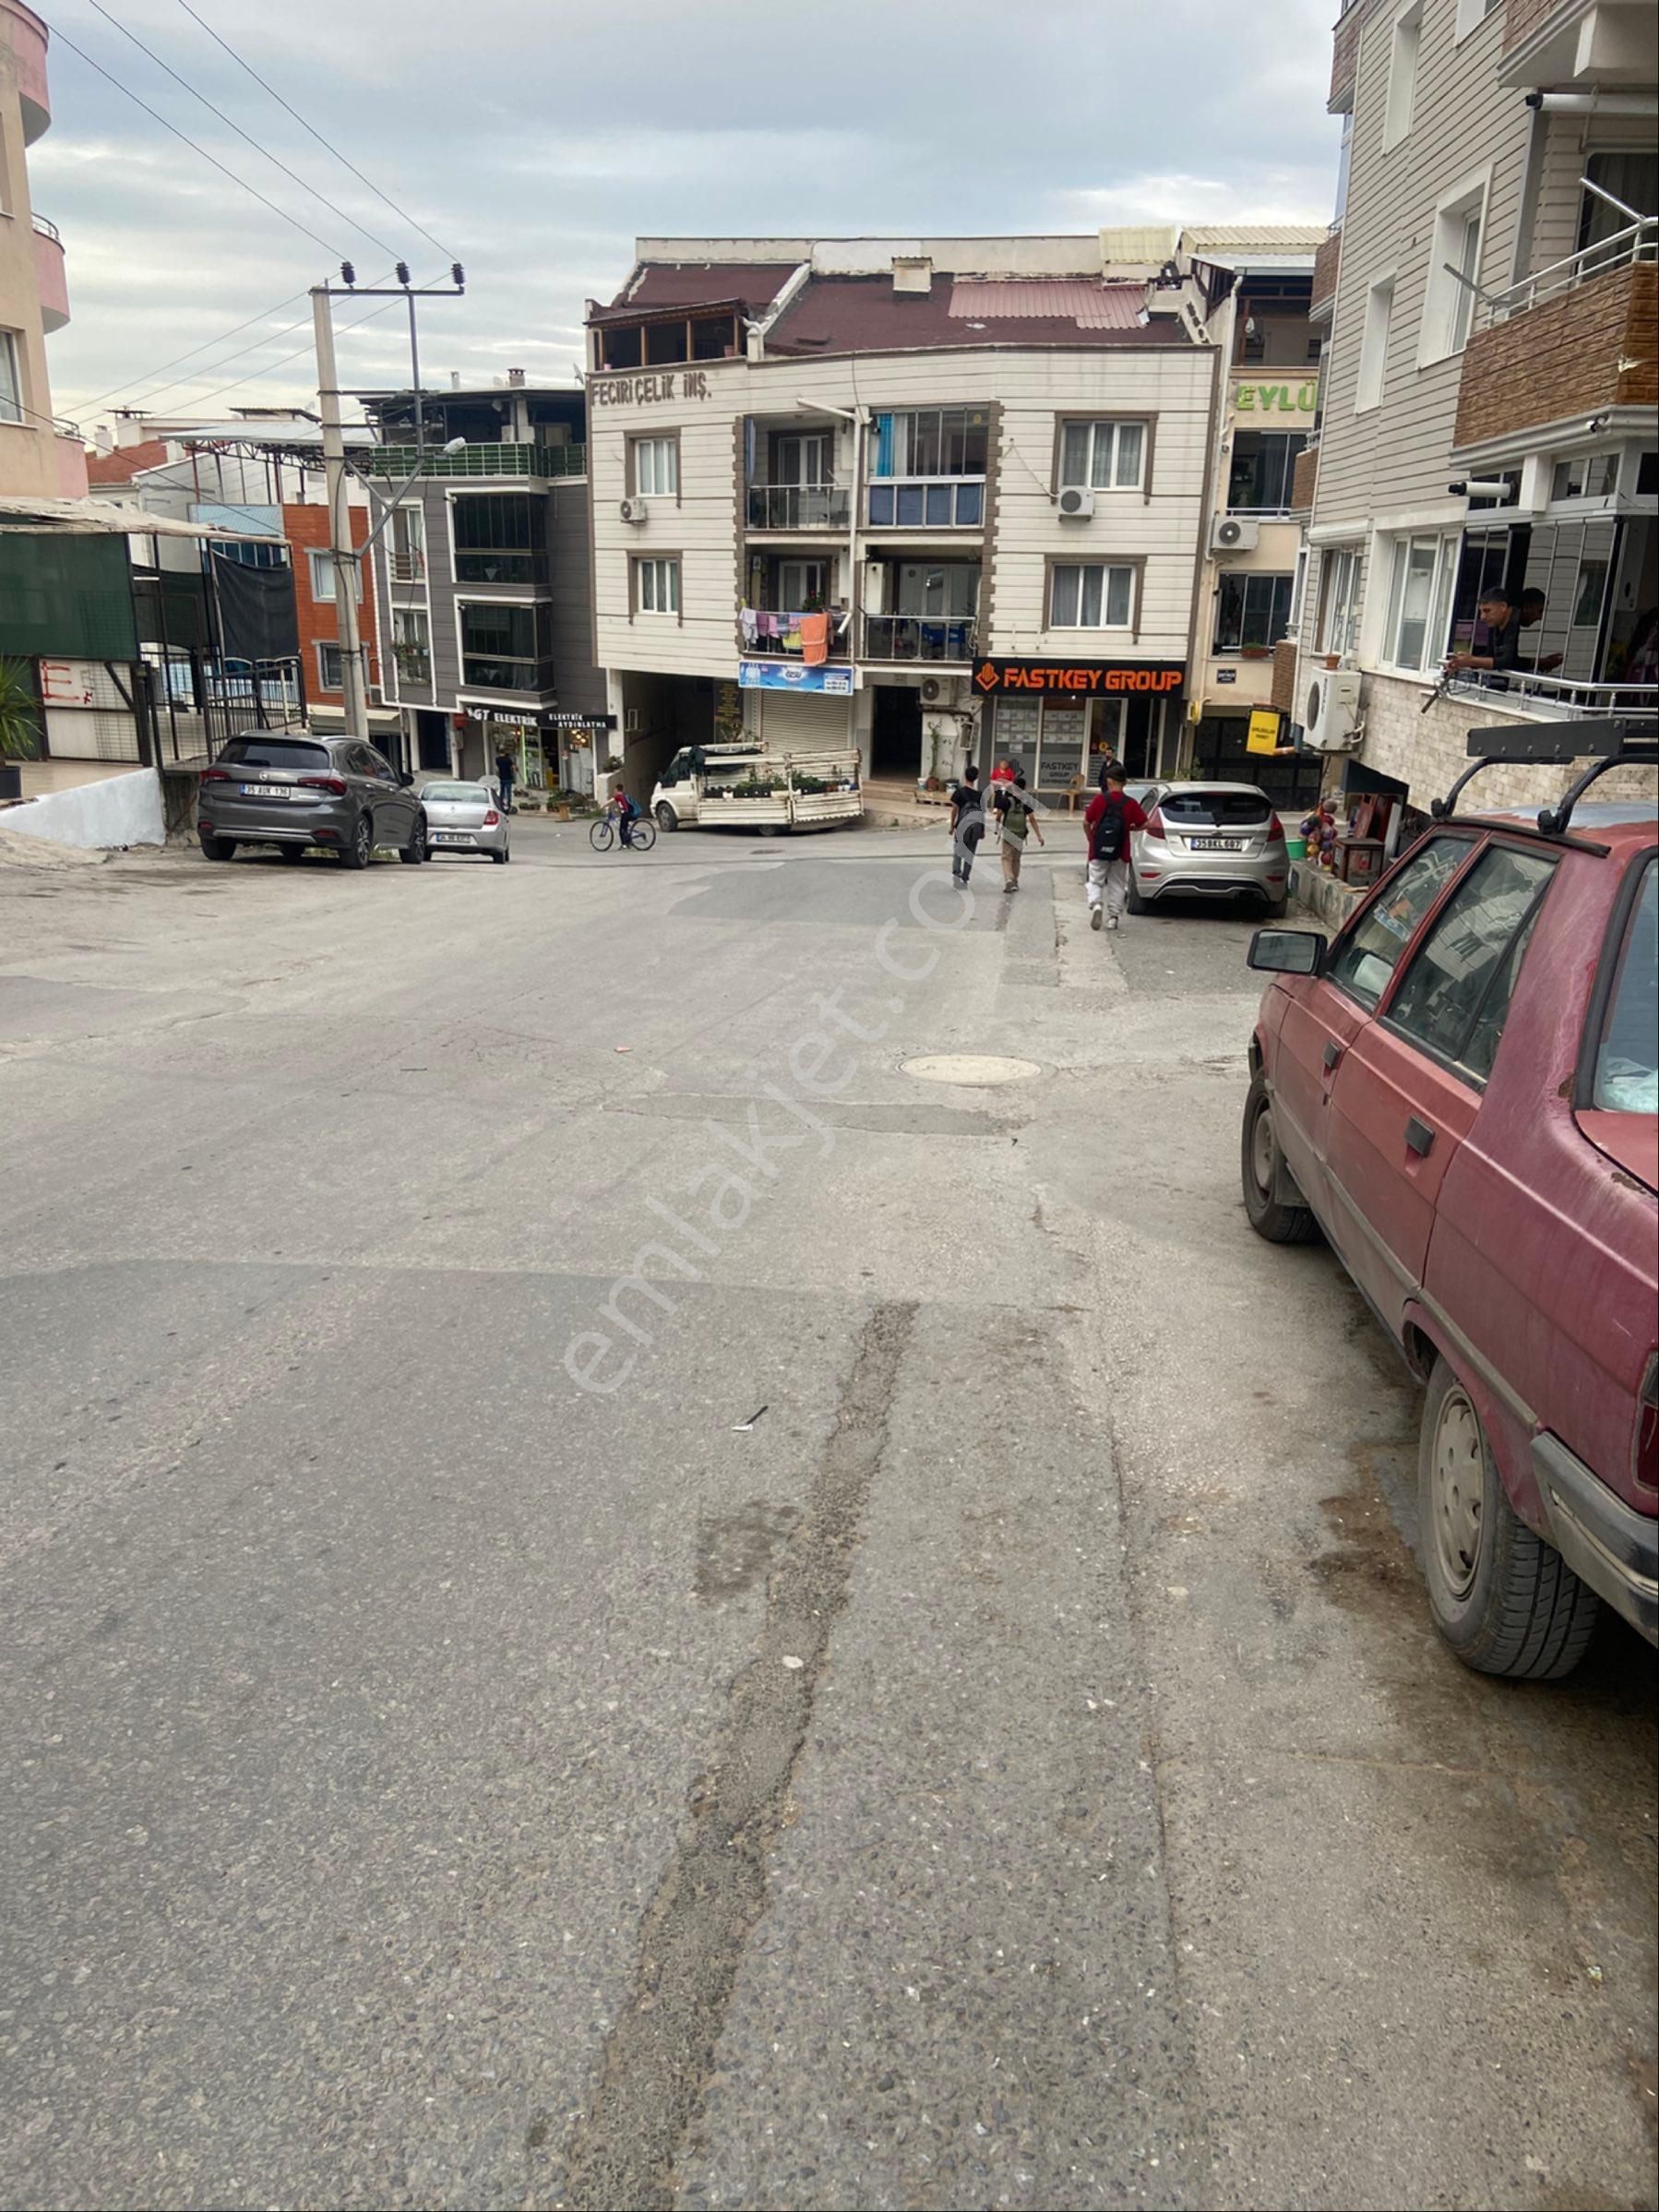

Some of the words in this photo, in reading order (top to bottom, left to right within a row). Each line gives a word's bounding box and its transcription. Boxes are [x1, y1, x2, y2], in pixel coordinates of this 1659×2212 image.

[635, 374, 674, 405] ÇELİK
[1003, 667, 1103, 689] FASTKEY
[1105, 670, 1182, 690] GROUP
[1041, 761, 1079, 771] FASTKEY
